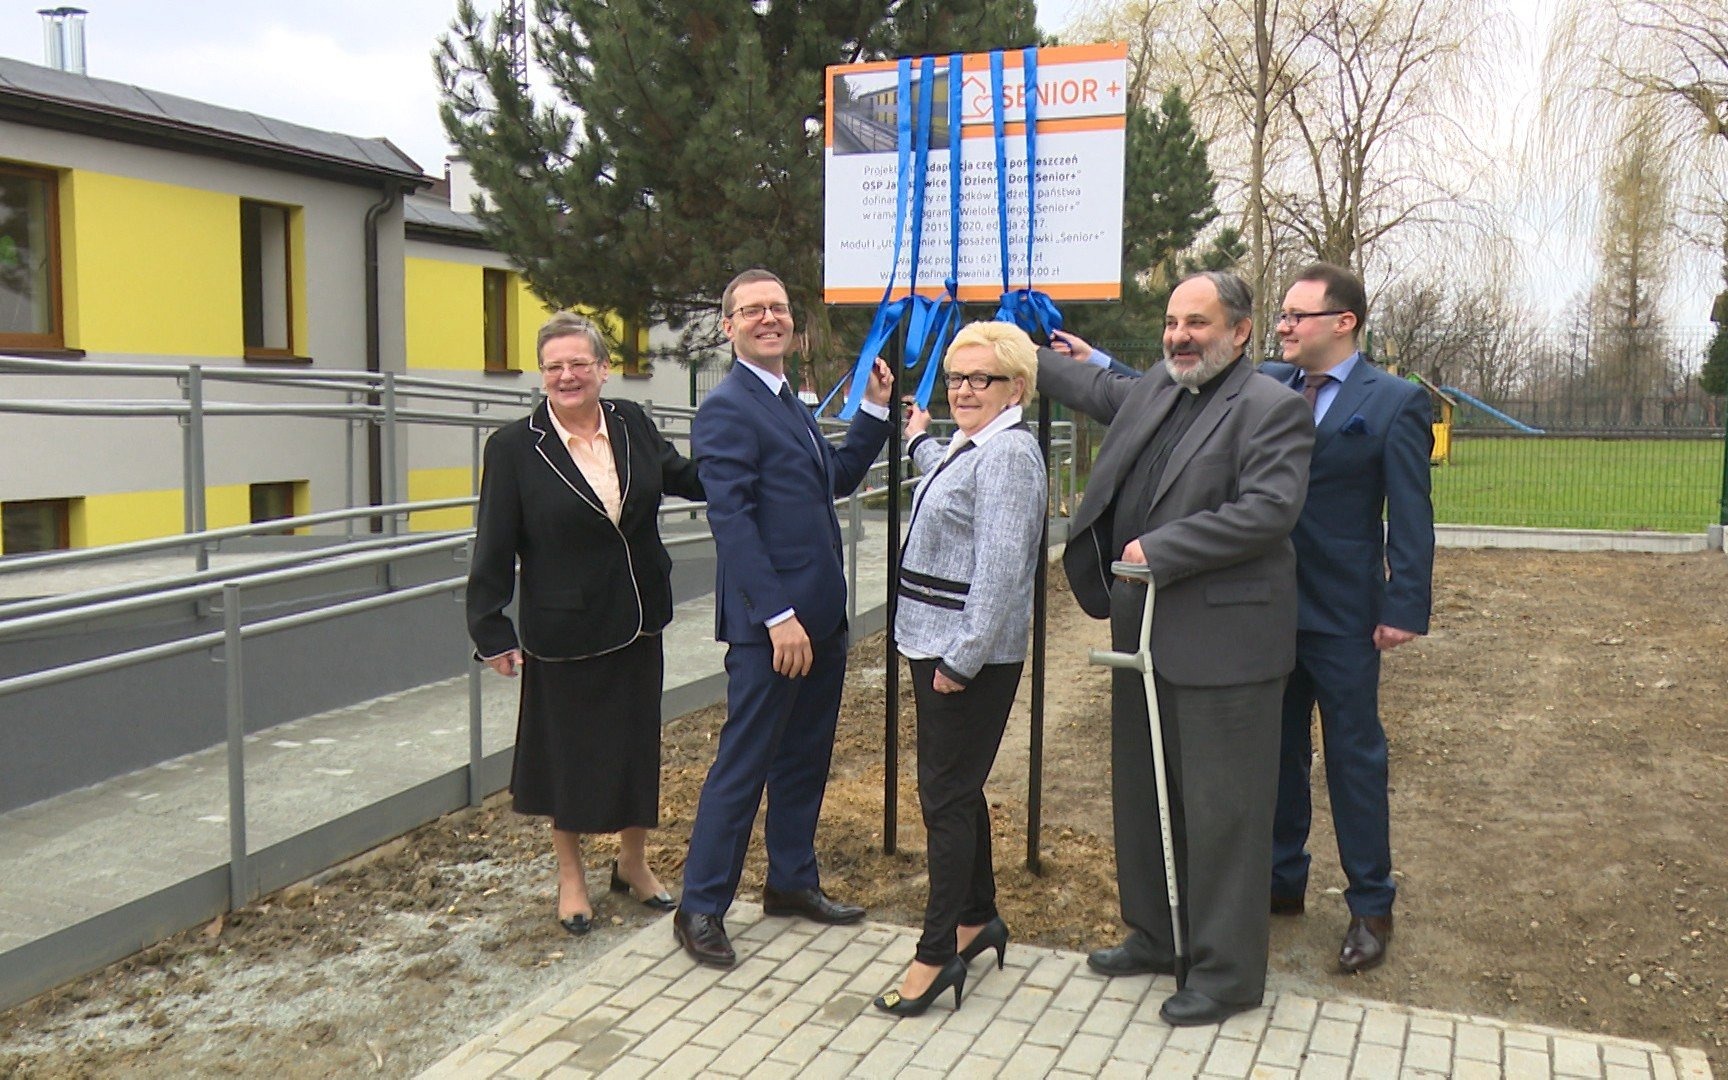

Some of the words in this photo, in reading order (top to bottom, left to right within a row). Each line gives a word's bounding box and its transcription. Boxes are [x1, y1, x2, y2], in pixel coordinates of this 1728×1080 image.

[1002, 78, 1098, 109] SENIOR
[864, 164, 897, 176] Projekt
[1009, 154, 1078, 169] poeszczeń
[862, 181, 883, 192] OSP
[936, 195, 947, 203] ze
[925, 222, 949, 232] 2015
